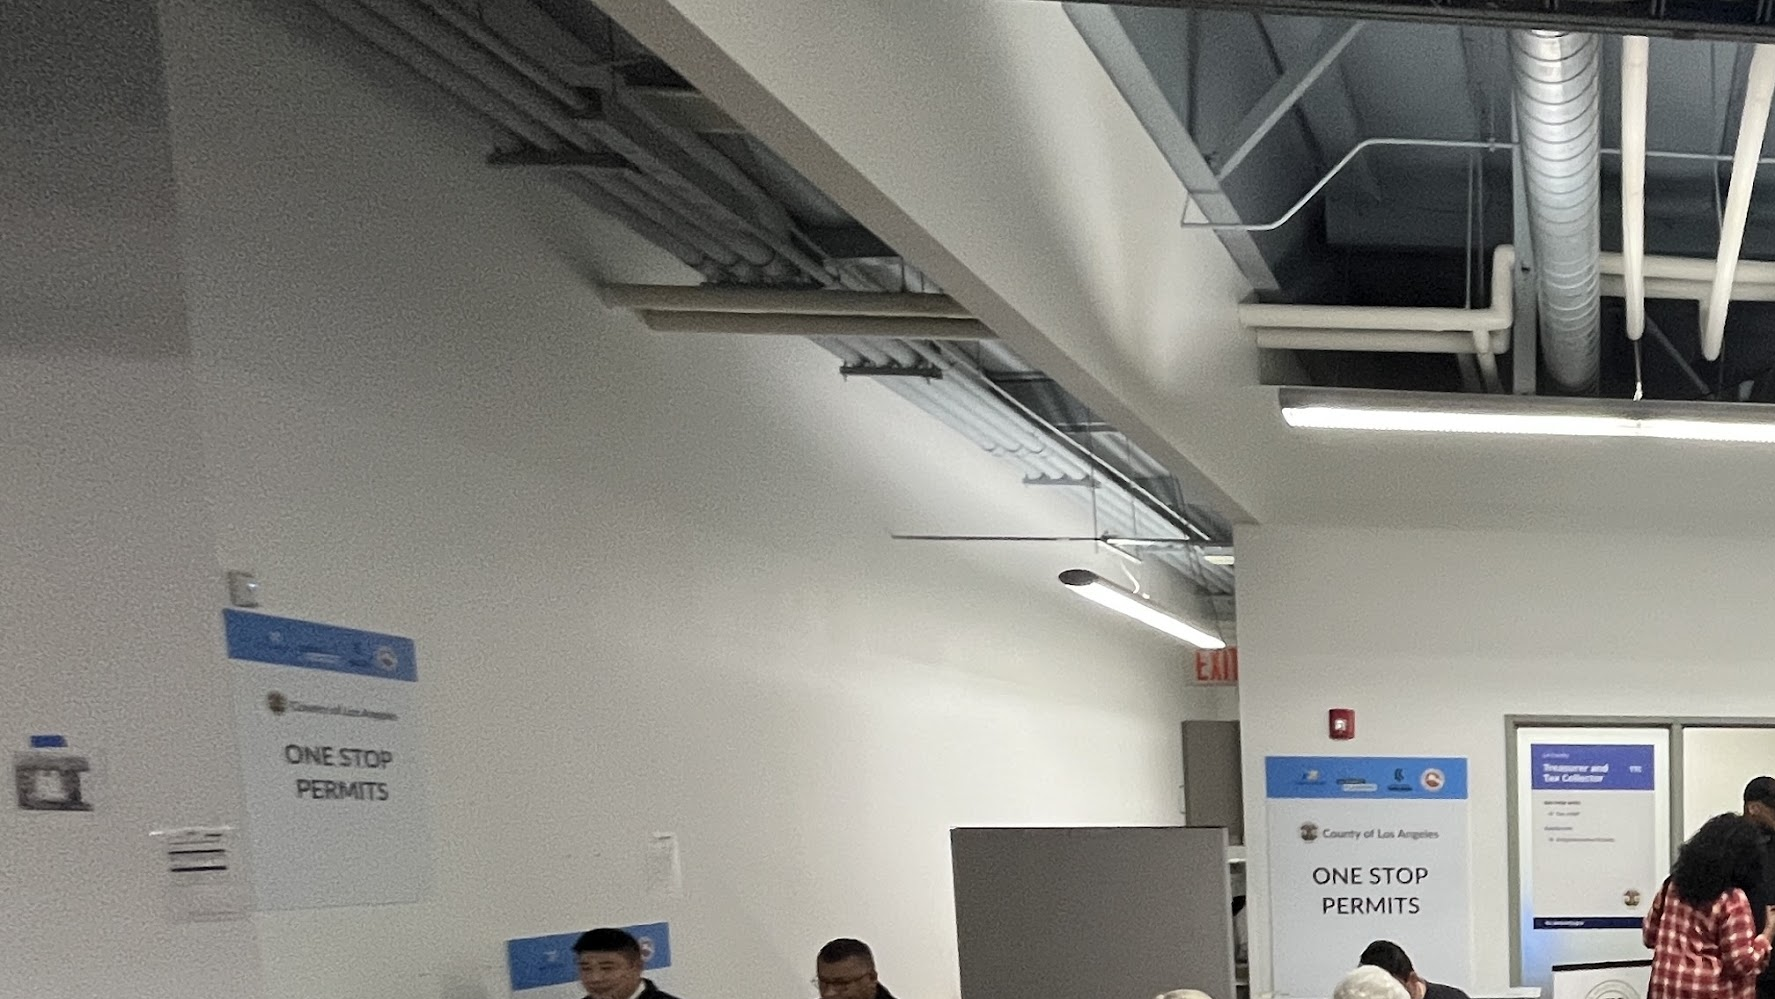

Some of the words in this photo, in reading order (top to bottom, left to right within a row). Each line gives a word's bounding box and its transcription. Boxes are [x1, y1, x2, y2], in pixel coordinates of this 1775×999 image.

[1195, 648, 1238, 681] EXIT
[285, 744, 335, 767] ONE
[339, 747, 393, 769] STOP
[296, 779, 390, 801] PERMITS
[1322, 828, 1361, 840] County
[1363, 828, 1375, 839] of
[1377, 828, 1395, 839] Los
[1397, 828, 1439, 840] Angeles
[1312, 867, 1363, 885] ONE
[1368, 867, 1429, 885] STOP
[1322, 897, 1420, 915] PERMITS
